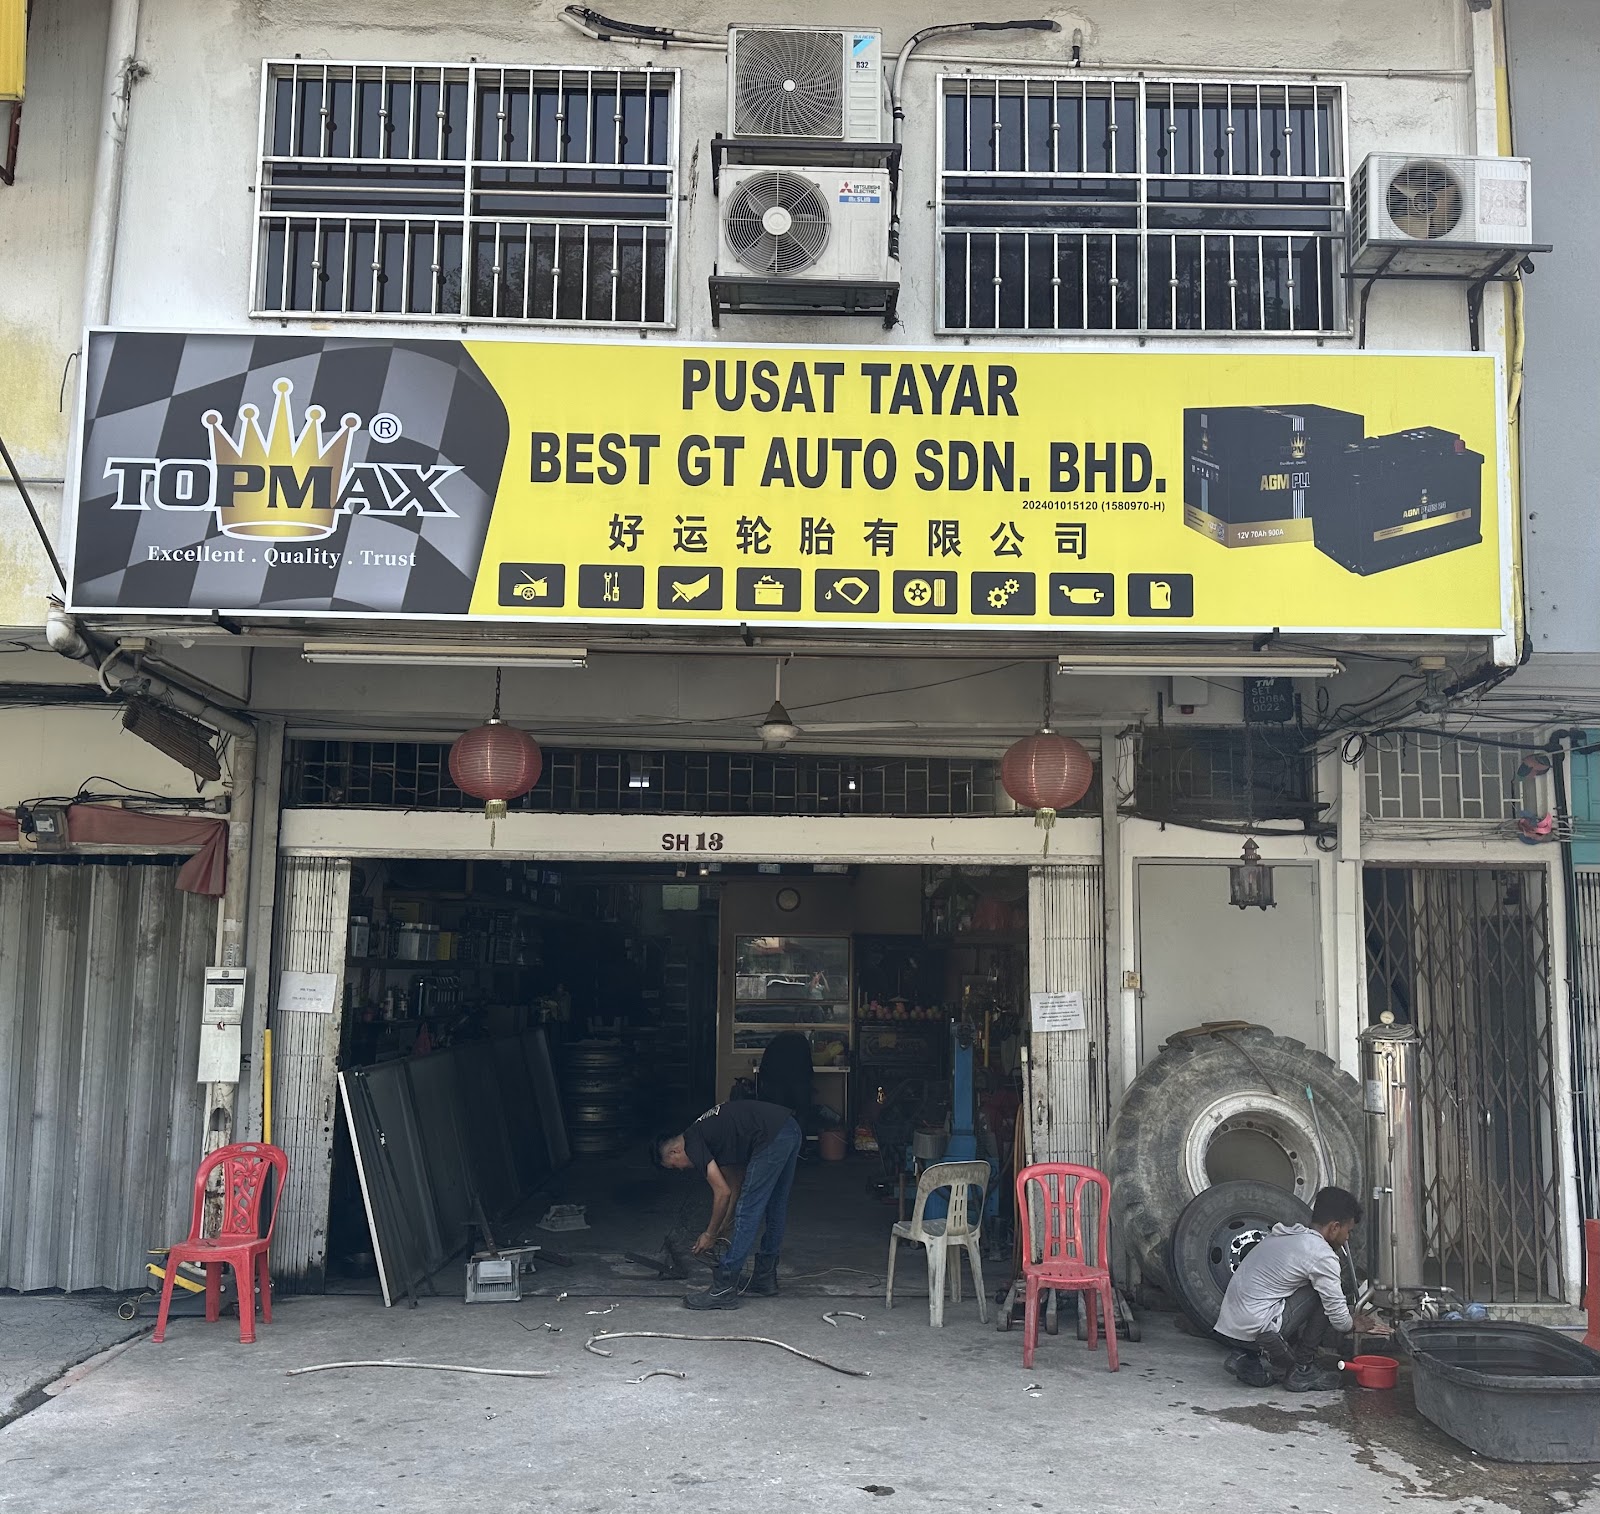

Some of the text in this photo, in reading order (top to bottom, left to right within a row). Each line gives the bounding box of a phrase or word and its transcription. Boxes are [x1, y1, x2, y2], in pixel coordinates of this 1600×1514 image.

[856, 61, 869, 69] R32
[683, 359, 1019, 417] PUSAT TAYAR
[531, 432, 1167, 494] BEST GT AUTO SDN. BHD.
[103, 457, 465, 519] TOPMAX
[1260, 473, 1290, 491] AGM
[1022, 500, 1165, 513] 202401015120 (1580970-H)
[609, 514, 1089, 559] 好运轮胎有限公司
[1251, 530, 1267, 538] 70Ah
[147, 545, 245, 564] Excellent
[264, 547, 342, 569] Quality
[360, 550, 417, 567] Trust
[1251, 687, 1271, 696] SET
[1255, 679, 1275, 687] TM
[661, 832, 724, 851] SH 13
